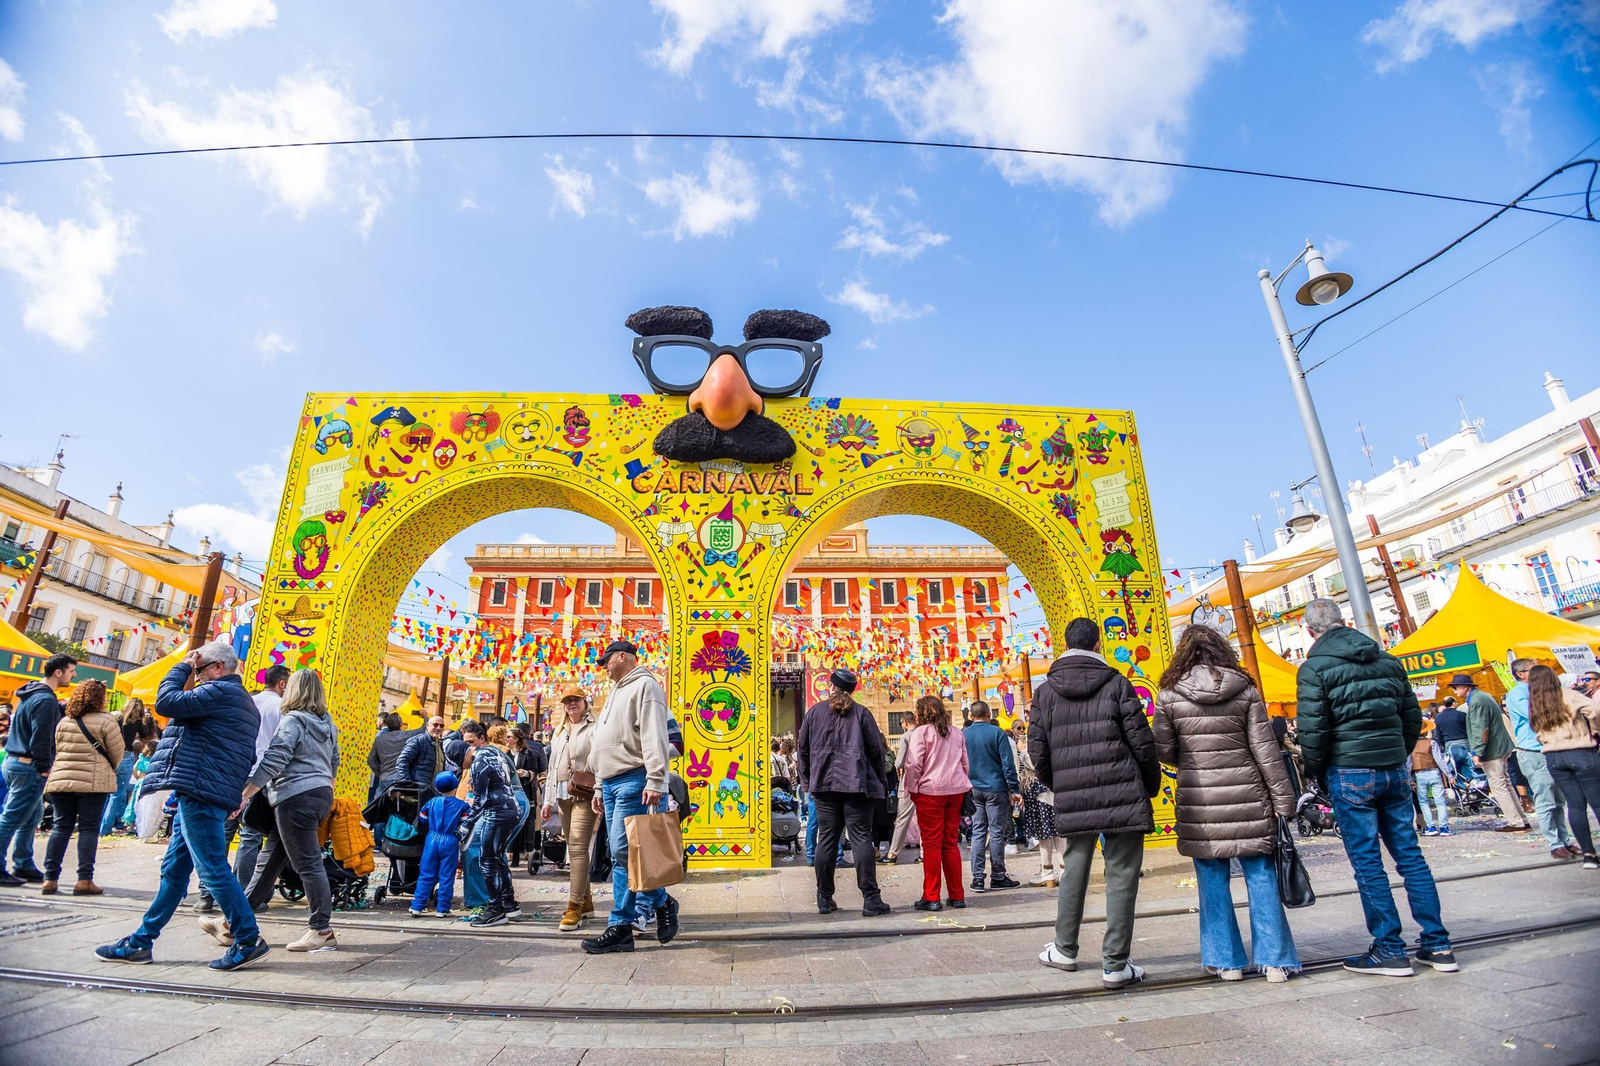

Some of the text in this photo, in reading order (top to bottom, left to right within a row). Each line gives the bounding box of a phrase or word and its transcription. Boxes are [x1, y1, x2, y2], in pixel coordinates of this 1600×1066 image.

[311, 461, 347, 477] CARNAVAL
[631, 470, 814, 496] CARNAVAL
[1102, 479, 1113, 488] DEL
[305, 499, 338, 515] TE QUIERO
[1102, 498, 1110, 508] AL
[1116, 496, 1124, 505] DE
[1107, 514, 1126, 526] MARZO
[758, 524, 775, 534] 2025
